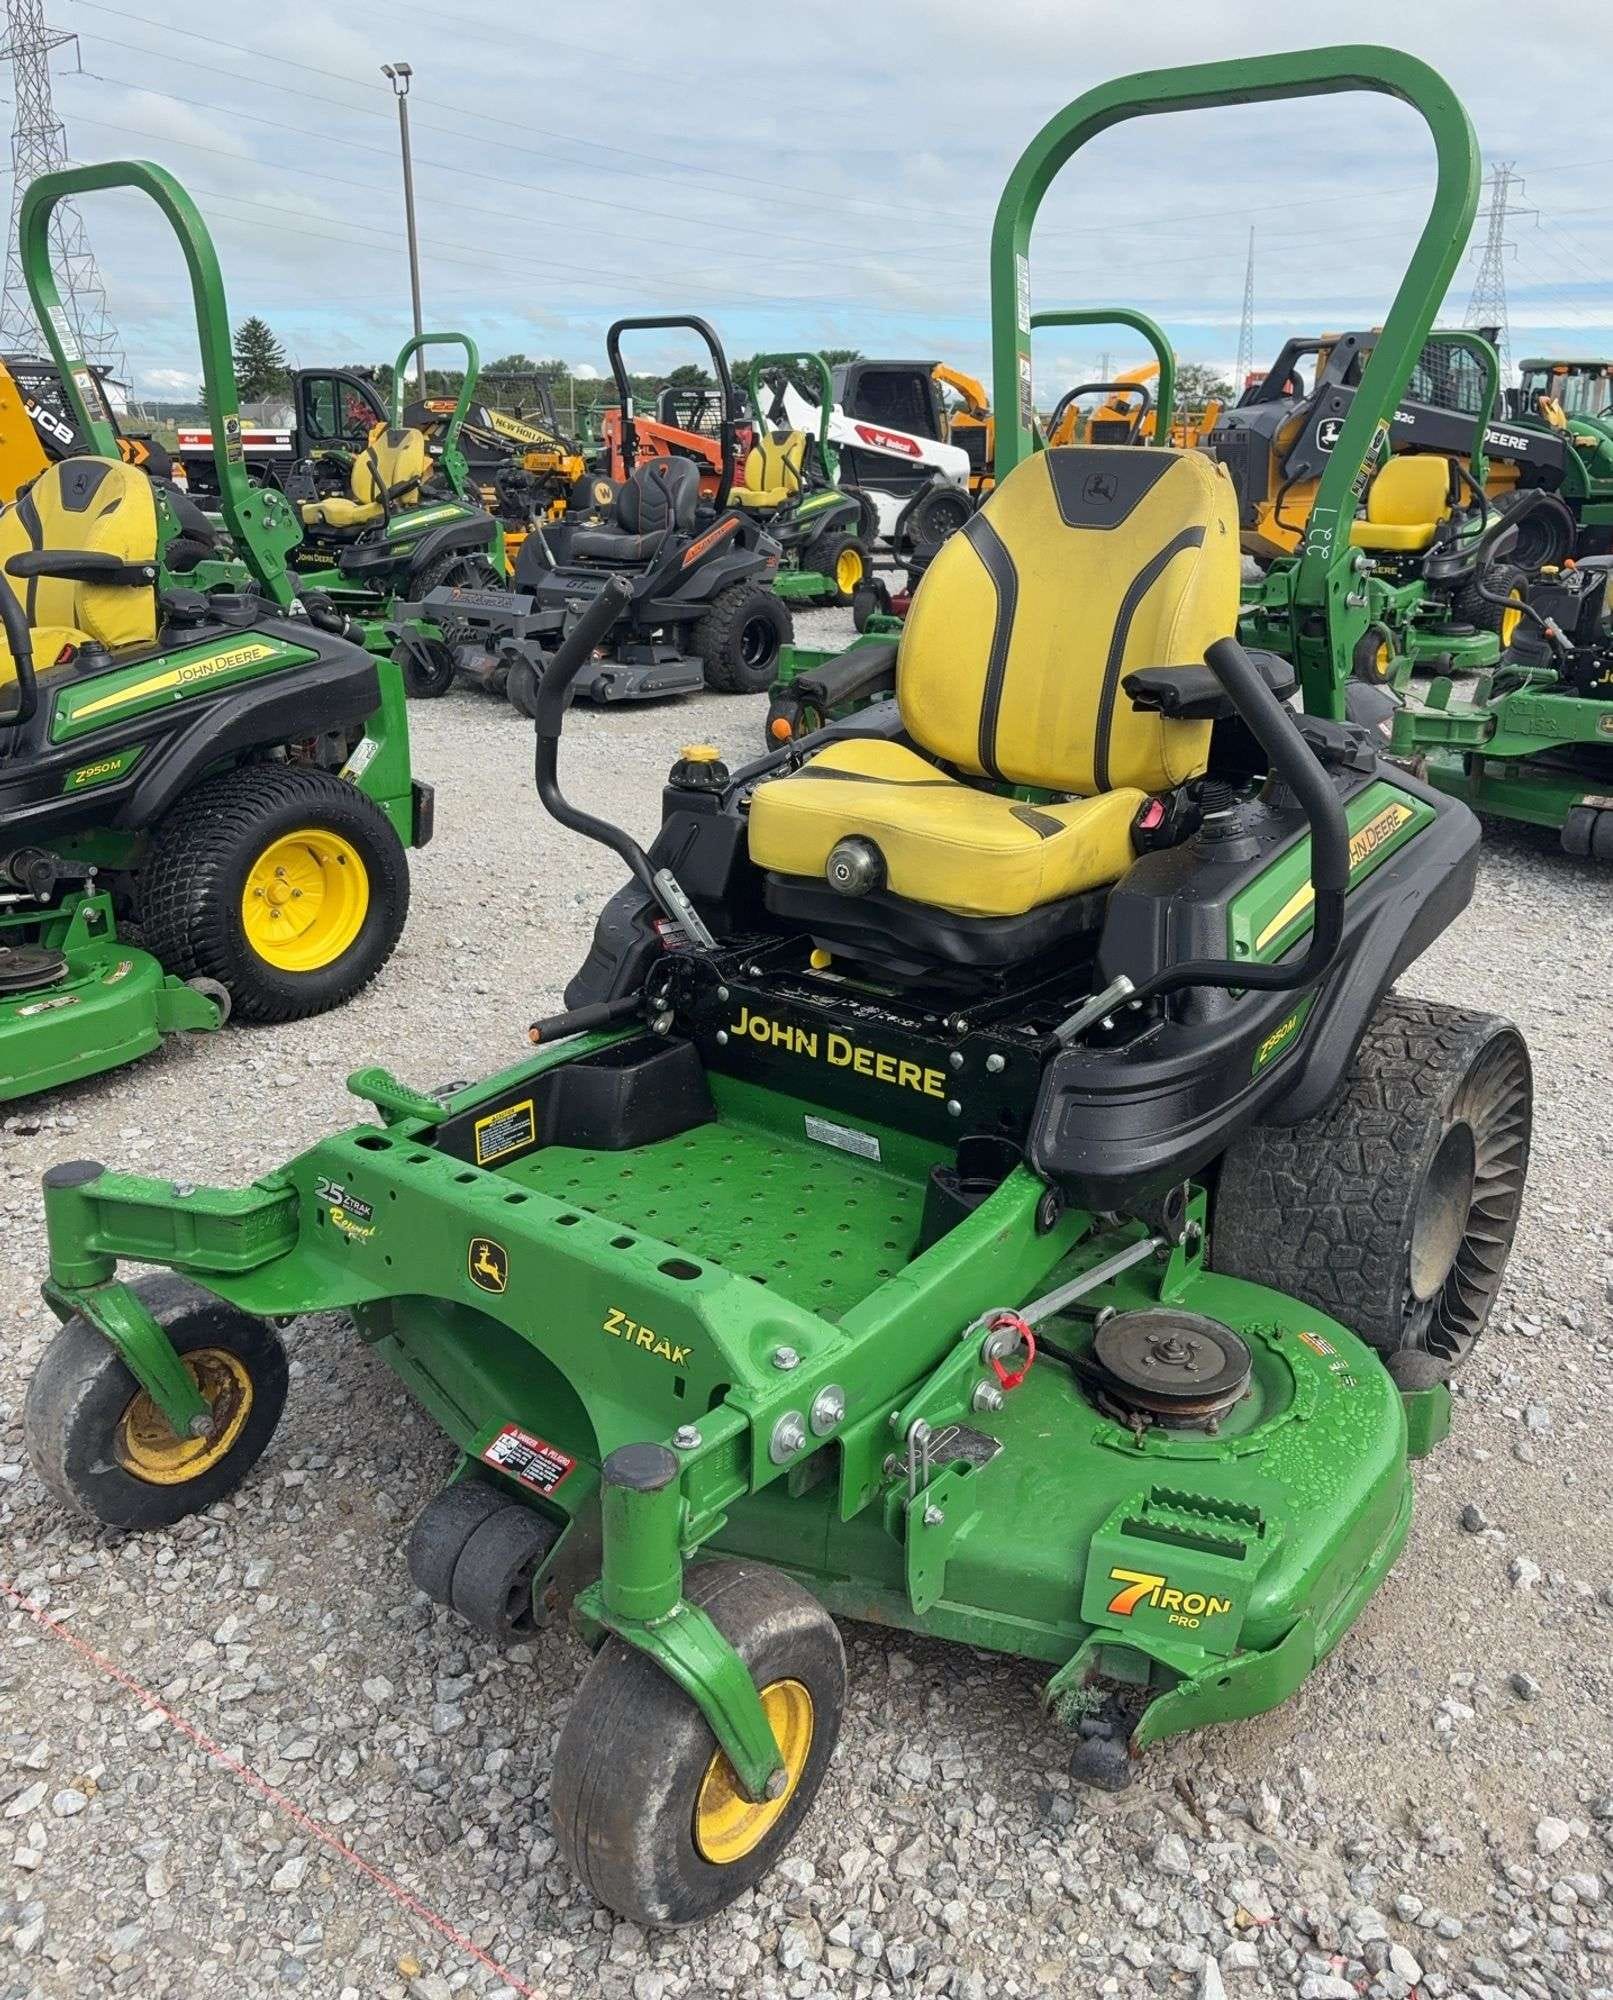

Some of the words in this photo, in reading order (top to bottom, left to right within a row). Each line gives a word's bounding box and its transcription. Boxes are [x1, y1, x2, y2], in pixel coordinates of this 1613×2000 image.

[24, 404, 75, 445] JCB
[1393, 410, 1416, 425] 32G
[298, 551, 314, 562] JOHN
[175, 664, 214, 683] JOHN
[215, 648, 262, 670] DEERE
[75, 760, 122, 783] Z950M
[1366, 809, 1401, 850] DEERE
[731, 1007, 818, 1058] JOHN
[827, 1032, 946, 1099] DEERE
[1259, 1015, 1297, 1063] Z950M
[314, 1176, 345, 1205] 25
[343, 1195, 371, 1215] ZTRAK
[603, 1307, 693, 1367] ZTRAK
[1107, 1567, 1167, 1616] 7
[1149, 1585, 1231, 1617] IRON
[1167, 1614, 1200, 1629] PRO
